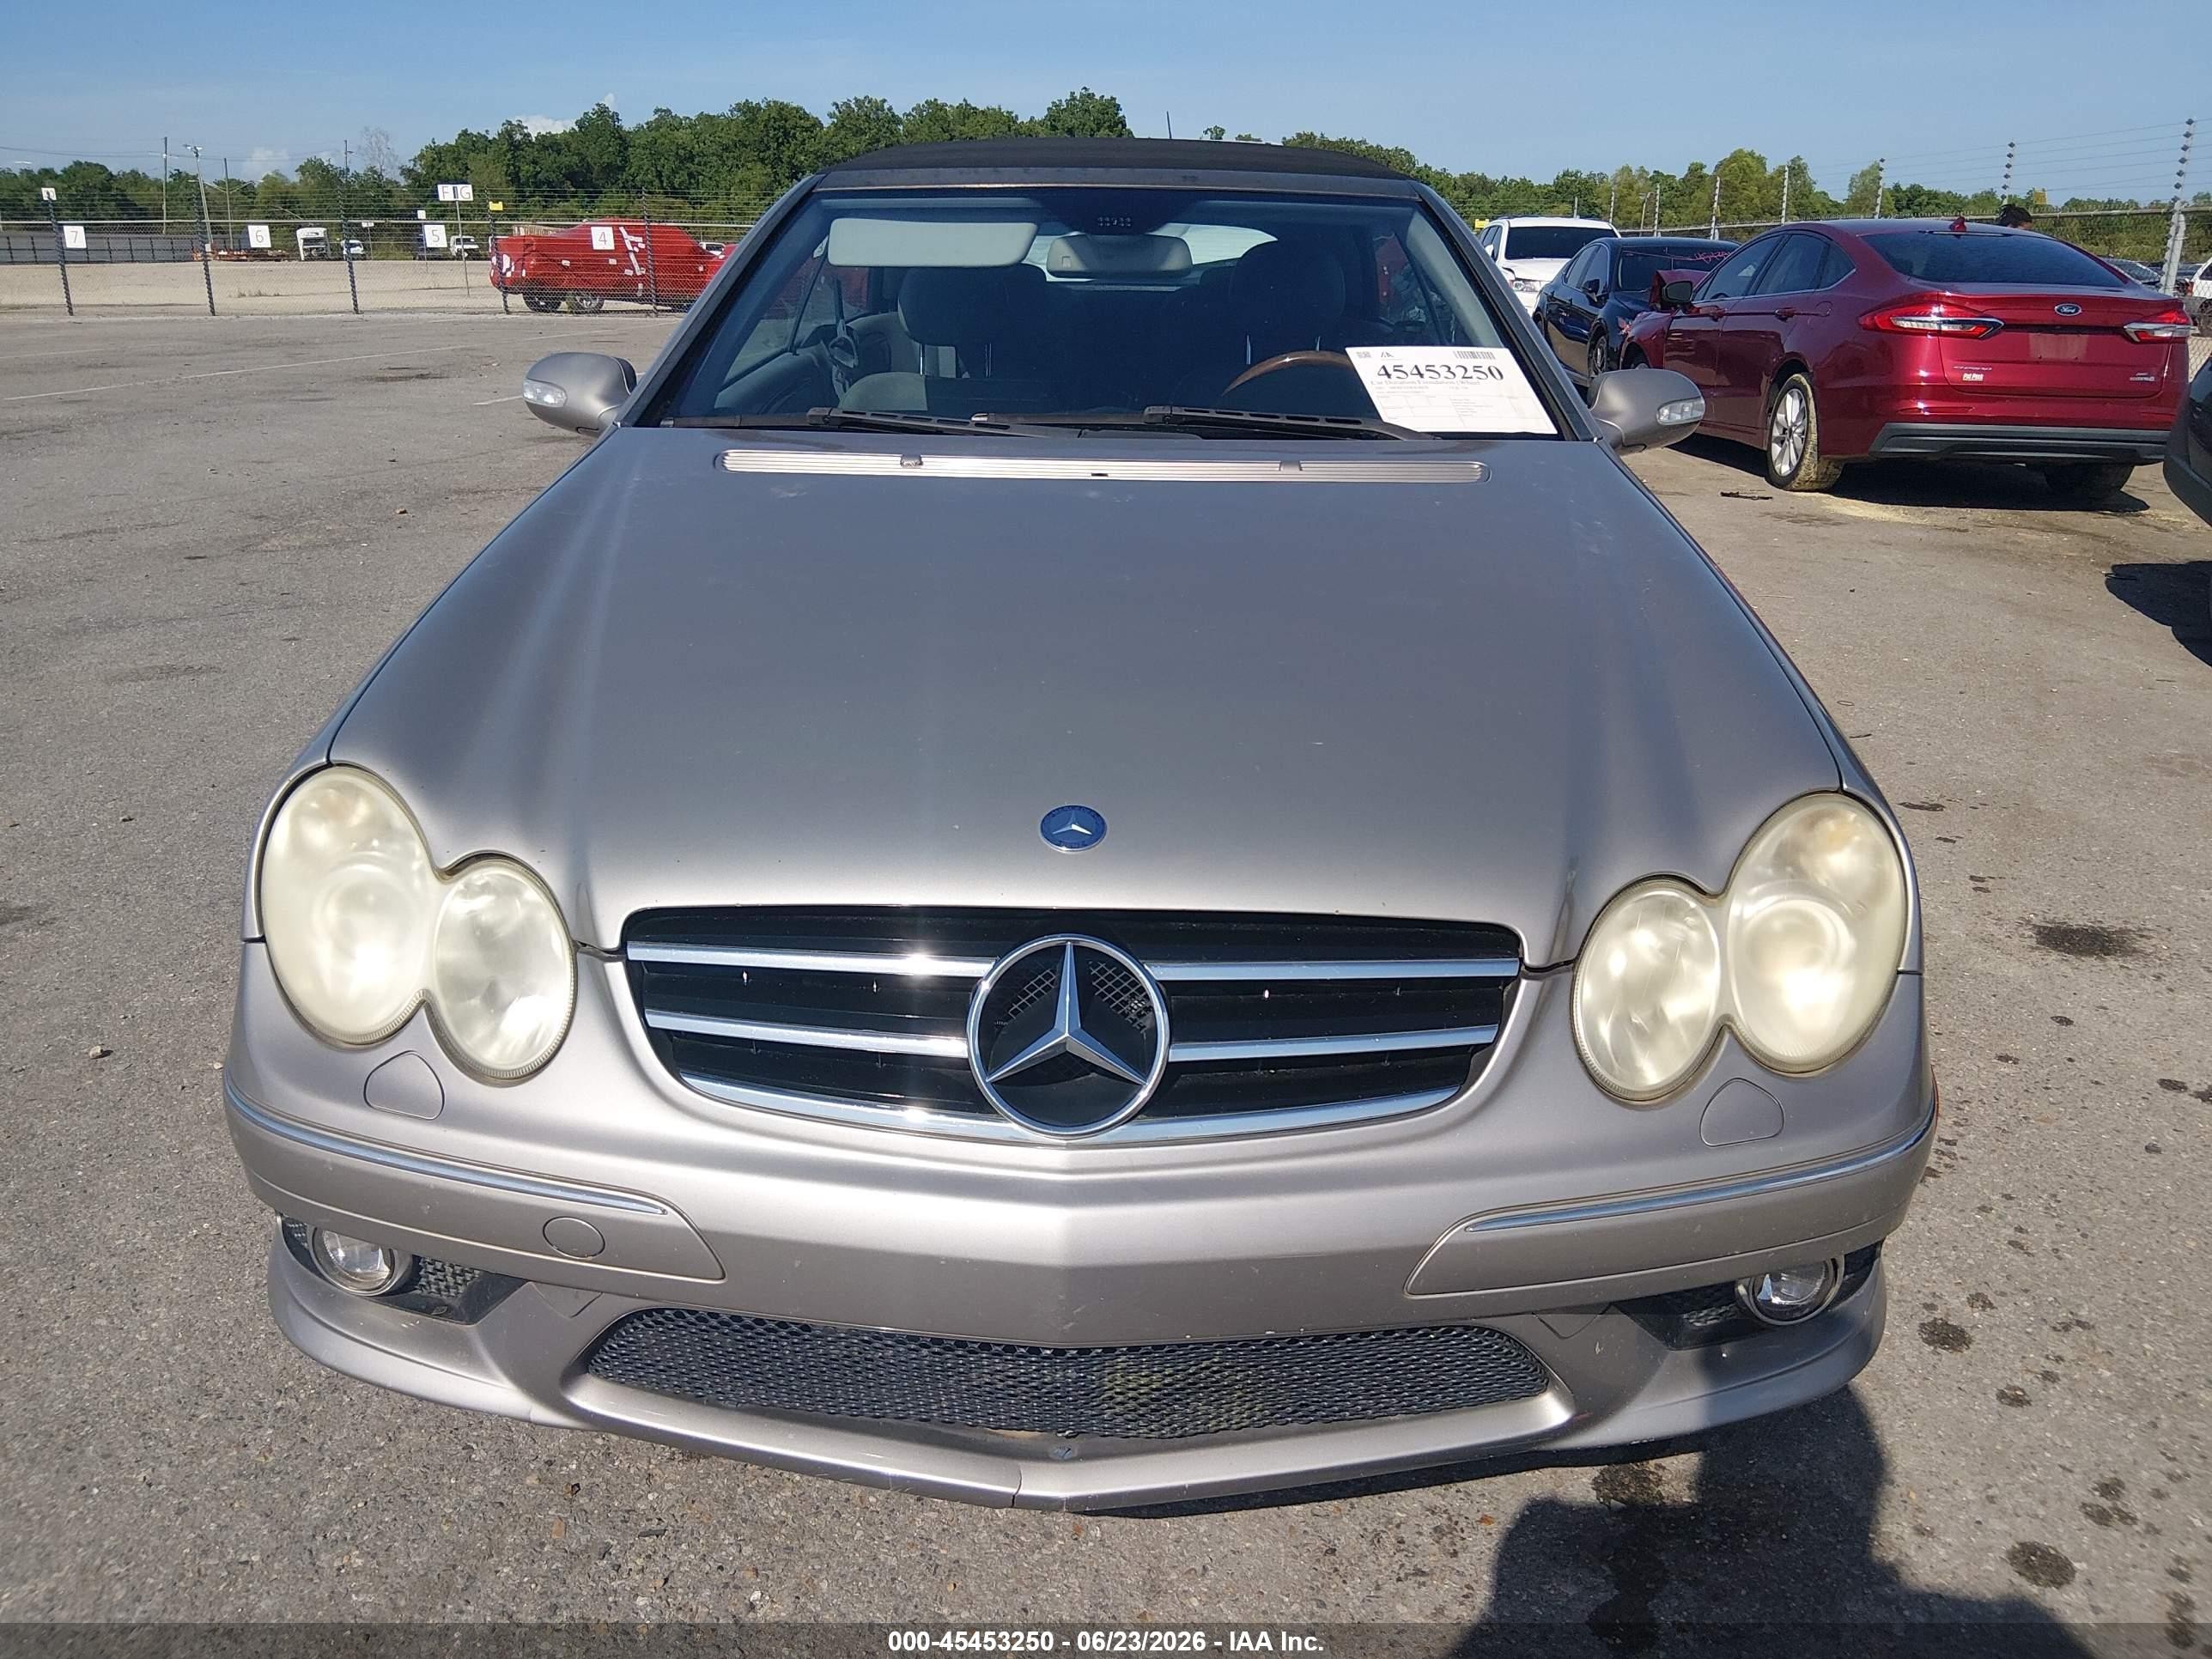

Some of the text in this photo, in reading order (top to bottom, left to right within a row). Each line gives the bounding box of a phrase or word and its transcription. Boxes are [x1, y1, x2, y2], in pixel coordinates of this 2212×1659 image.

[441, 185, 471, 199] F G
[69, 230, 78, 243] 7
[255, 229, 264, 243] 6
[431, 229, 441, 243] 5
[598, 231, 608, 245] 4
[1376, 364, 1504, 380] 45453250
